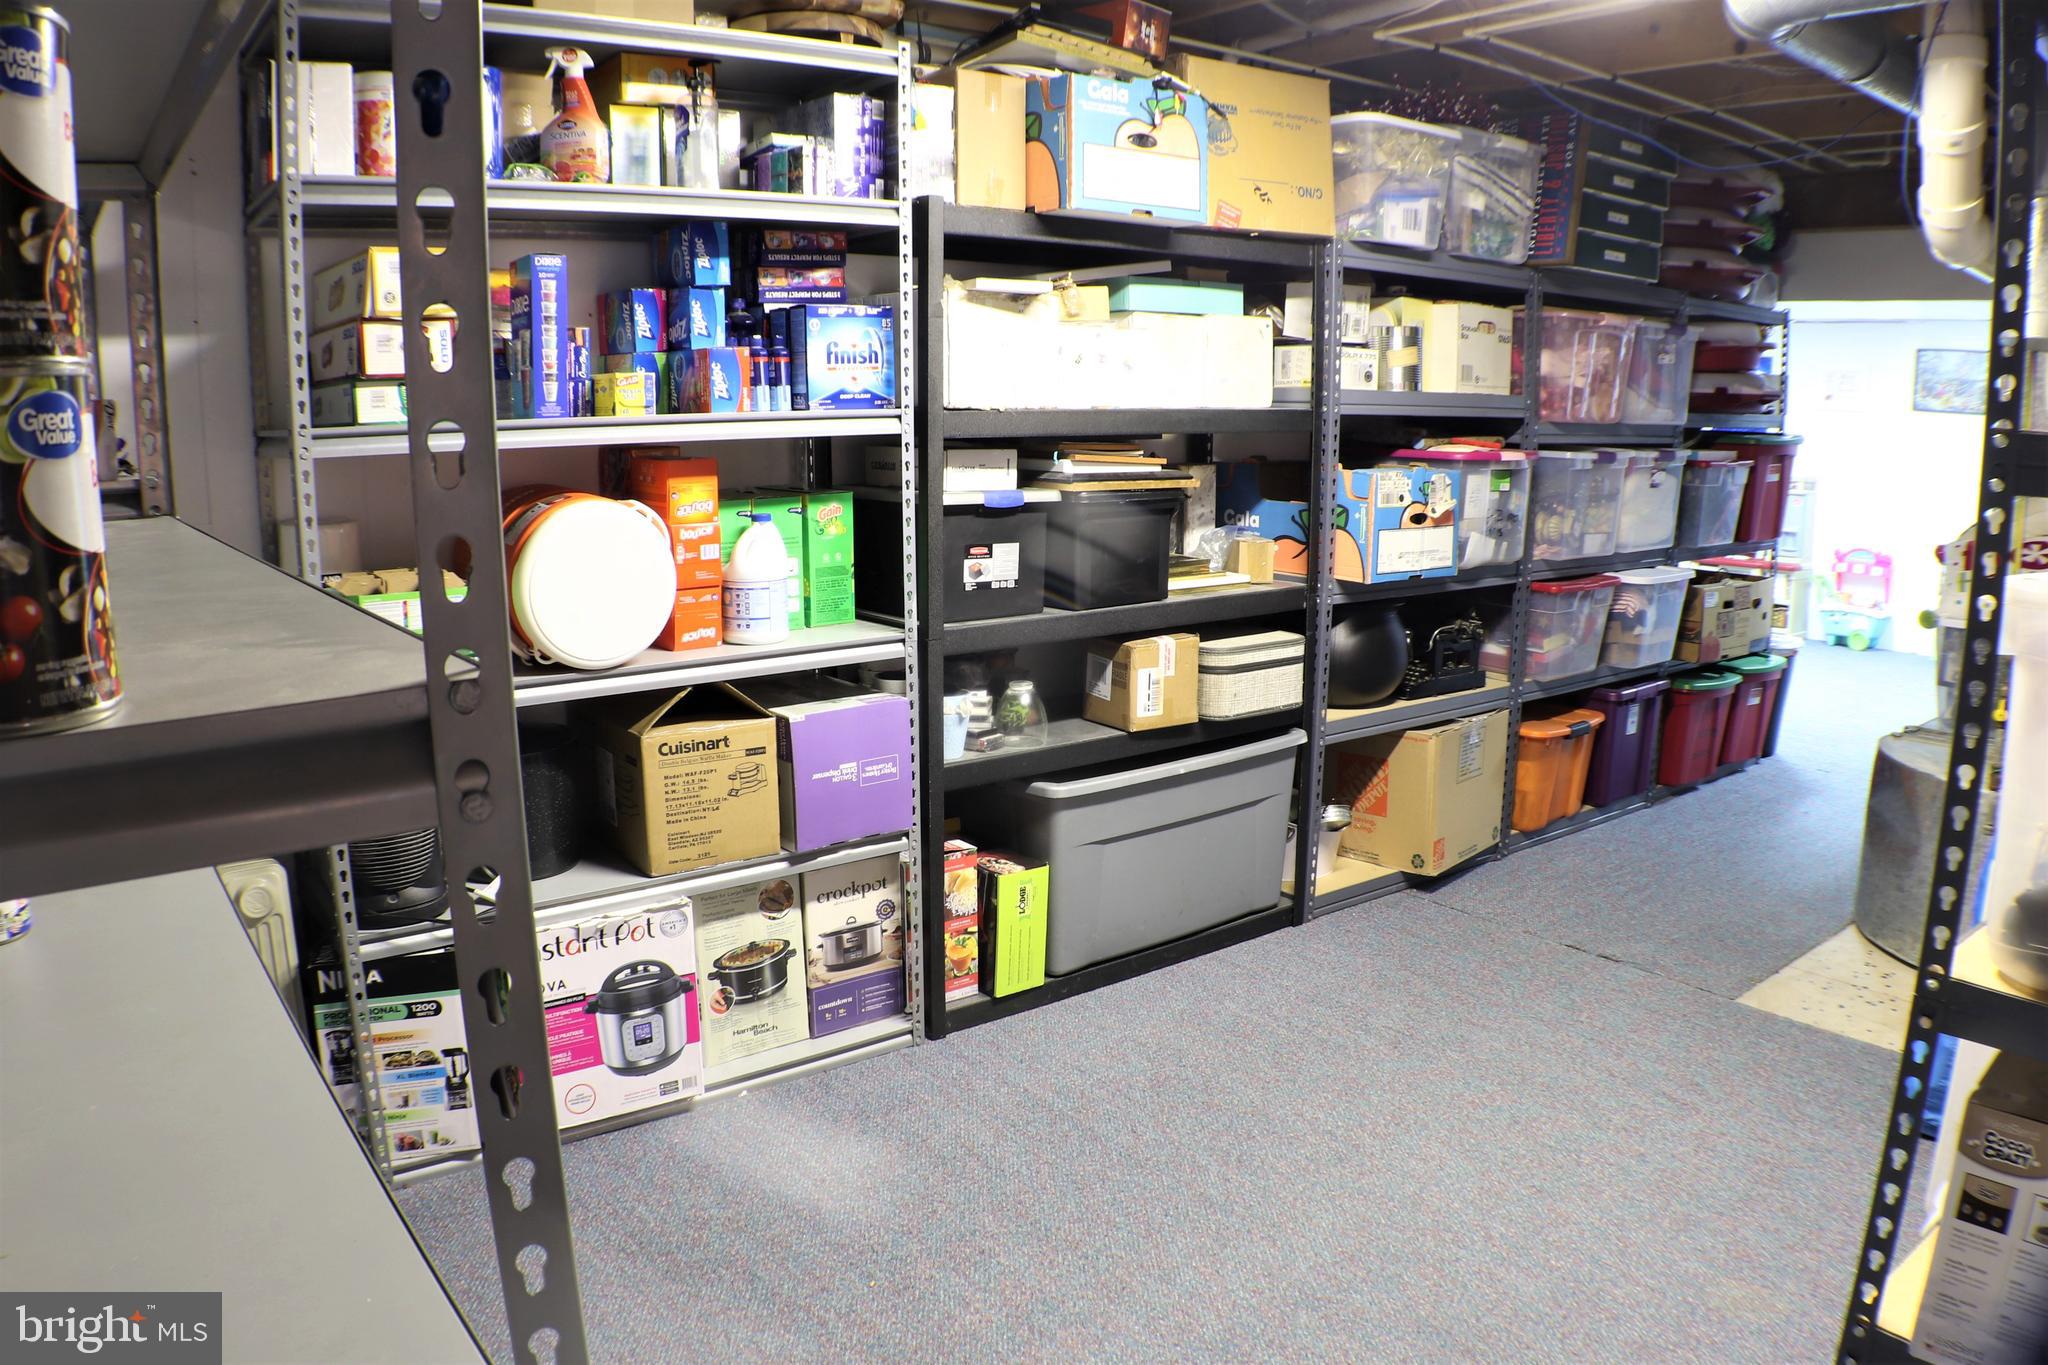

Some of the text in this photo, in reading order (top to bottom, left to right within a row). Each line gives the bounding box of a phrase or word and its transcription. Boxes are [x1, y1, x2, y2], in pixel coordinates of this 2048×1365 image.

[695, 237, 711, 269] Ziploc
[634, 303, 653, 339] Ziploc
[691, 299, 710, 337] Ziploc
[439, 329, 449, 363] SOLO
[826, 341, 879, 364] finish
[616, 375, 639, 386] GLAD
[711, 361, 730, 400] Ziploc
[18, 408, 75, 431] Great
[36, 429, 76, 445] Value
[676, 501, 713, 517] bounce
[818, 504, 843, 522] Gain
[1224, 509, 1260, 528] Gala
[680, 526, 714, 541] bounce
[682, 628, 716, 644] bounce
[658, 736, 730, 756] Cuisinart
[816, 877, 887, 904] crockpot
[1016, 886, 1026, 914] LODGE
[615, 917, 655, 946] Pot
[411, 1002, 437, 1012] 1200
[818, 996, 853, 1010] countdown
[732, 1024, 769, 1036] Hamilton
[753, 1026, 778, 1036] Beach
[1984, 1131, 2033, 1155] COCOA
[1983, 1146, 2031, 1166] CRAZY
